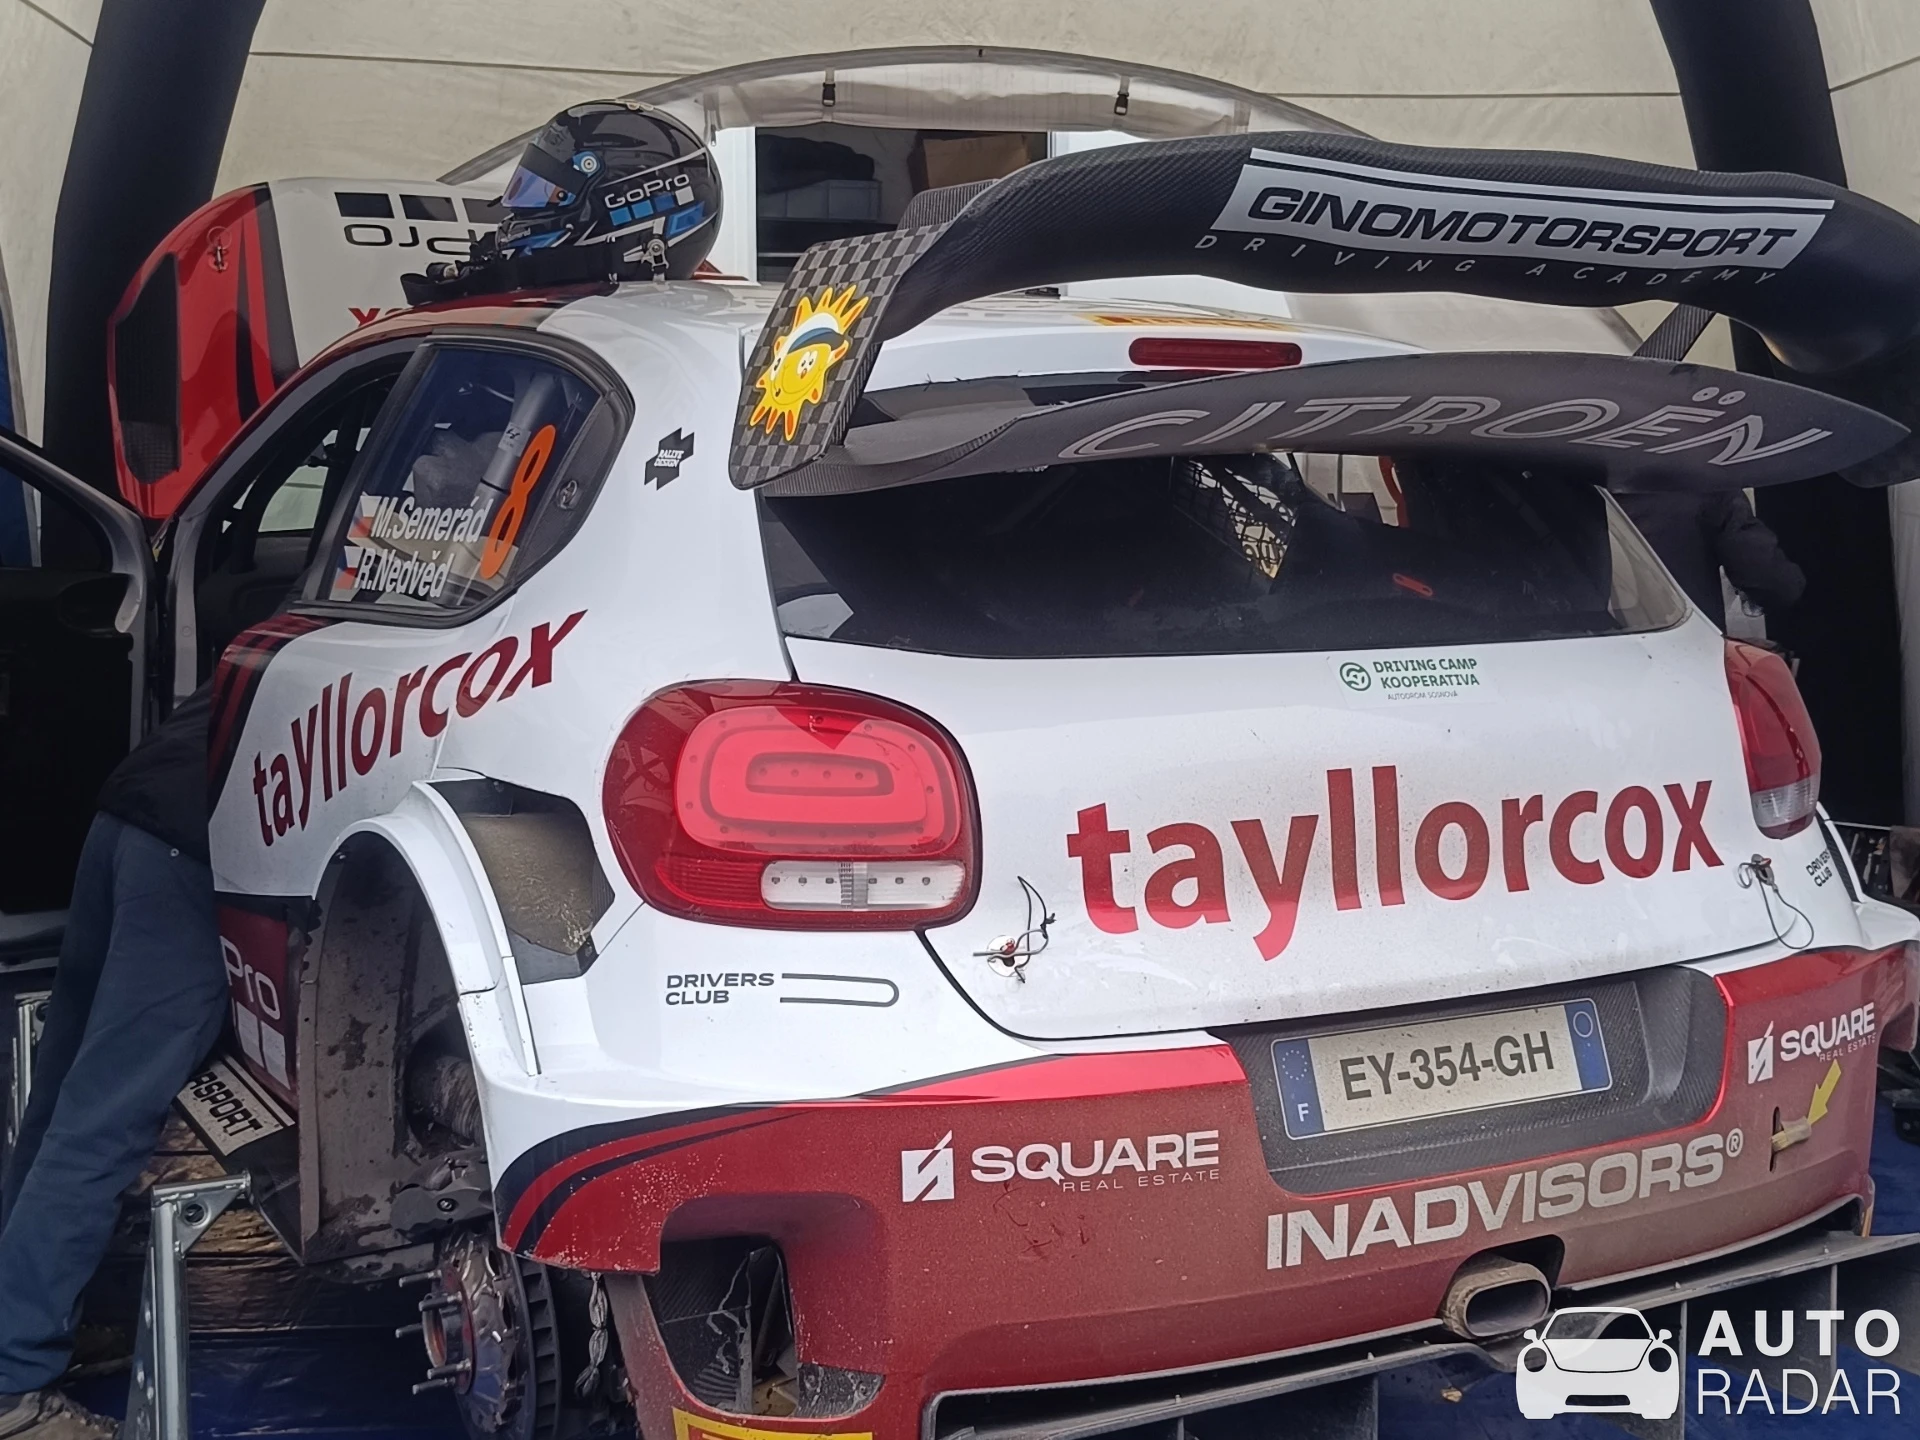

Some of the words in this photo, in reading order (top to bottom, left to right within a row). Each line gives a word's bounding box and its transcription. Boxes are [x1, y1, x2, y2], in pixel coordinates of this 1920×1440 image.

[604, 174, 690, 209] GoPro
[344, 223, 478, 256] Pro
[1247, 186, 1798, 258] GINOMOTORSPORT
[1194, 235, 1476, 272] DRIVING
[1525, 263, 1776, 286] ACADEMY
[1058, 385, 1833, 467] CITROËN
[479, 424, 557, 580] 8
[1373, 659, 1437, 673] DRIVING
[1439, 658, 1477, 671] CAMP
[1380, 673, 1480, 689] KOOPERATIVA
[252, 609, 588, 847] tayllorcox
[1066, 765, 1725, 961] tayllorcox
[220, 935, 281, 1020] Pro
[665, 989, 730, 1006] CLUB
[666, 972, 775, 989] DRIVERS
[1780, 1001, 1875, 1062] SQUARE
[1819, 1049, 1844, 1063] REAL
[1339, 1030, 1555, 1101] EY-354-GH
[1297, 1102, 1309, 1122] F
[970, 1129, 1220, 1186] SQUARE
[1062, 1177, 1124, 1192] REAL
[1137, 1168, 1220, 1187] ESTATE
